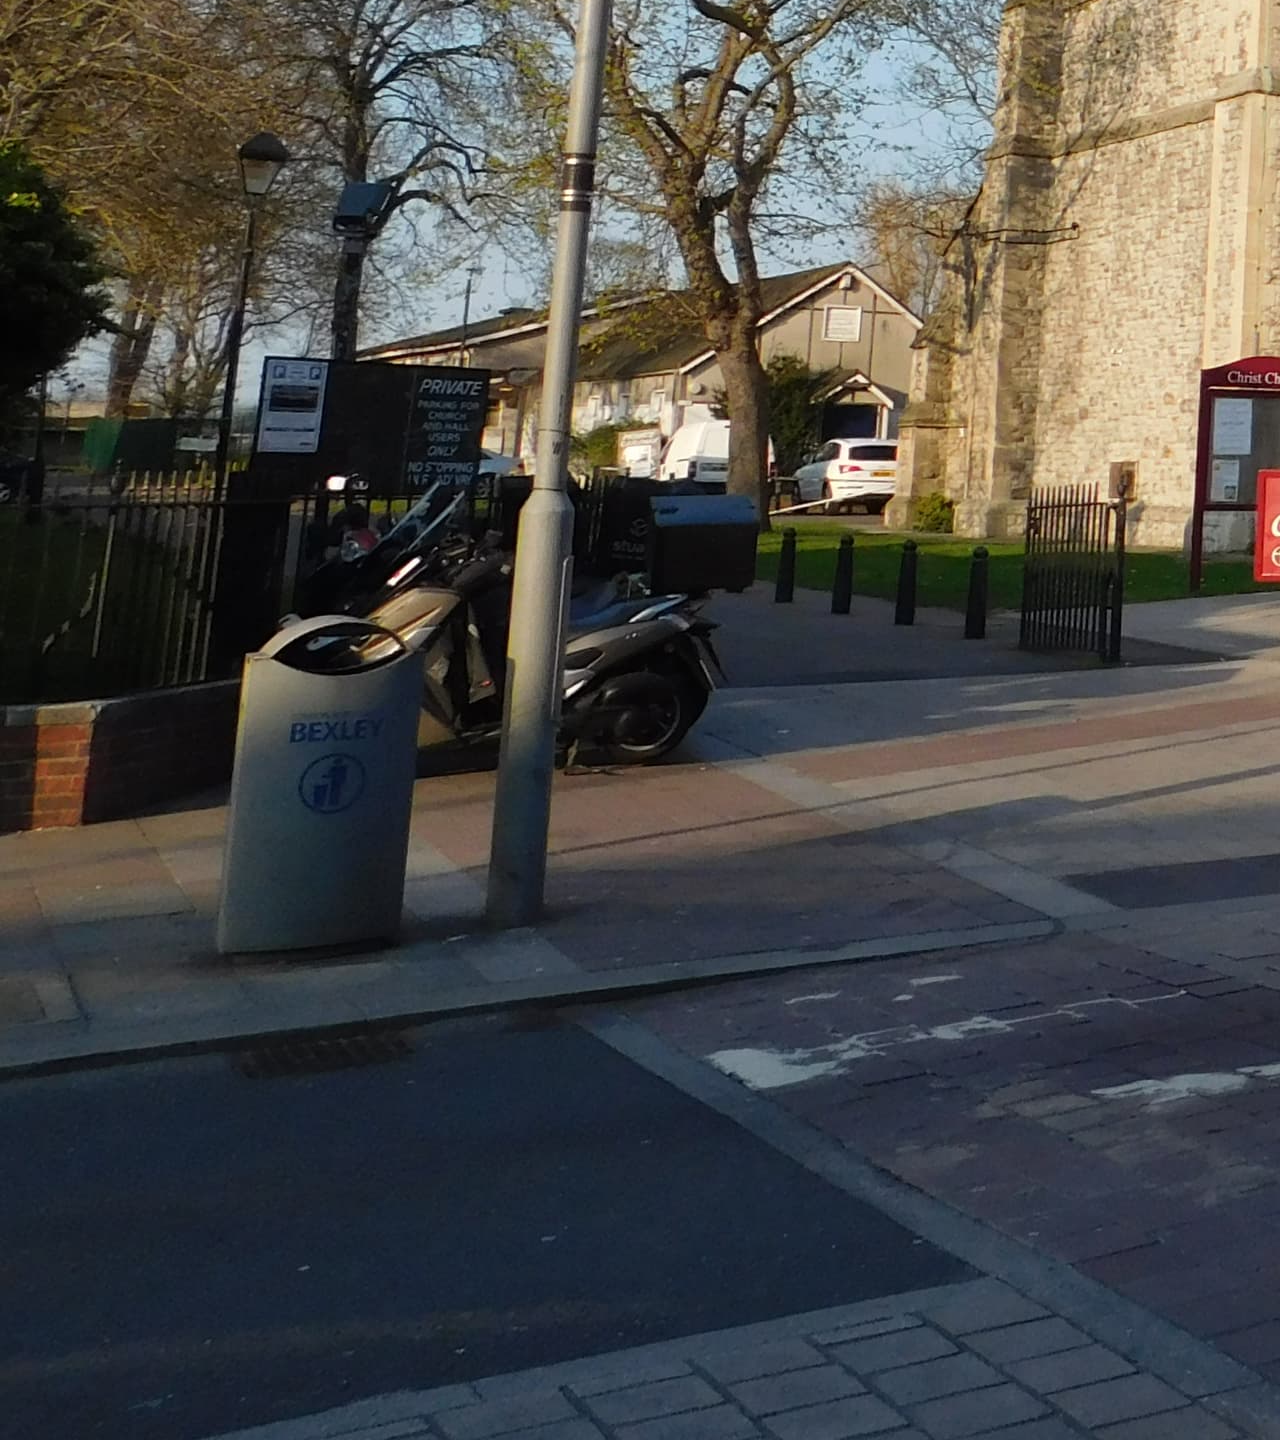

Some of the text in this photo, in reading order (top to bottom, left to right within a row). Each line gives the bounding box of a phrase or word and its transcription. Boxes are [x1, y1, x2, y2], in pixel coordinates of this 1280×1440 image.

[1227, 370, 1262, 384] Christ
[419, 378, 483, 396] PRIVATE
[417, 400, 457, 409] PARKING
[428, 411, 466, 420] CHURCH
[427, 445, 458, 456] ONLY
[407, 461, 423, 473] NO
[289, 718, 384, 743] BEXLEY
